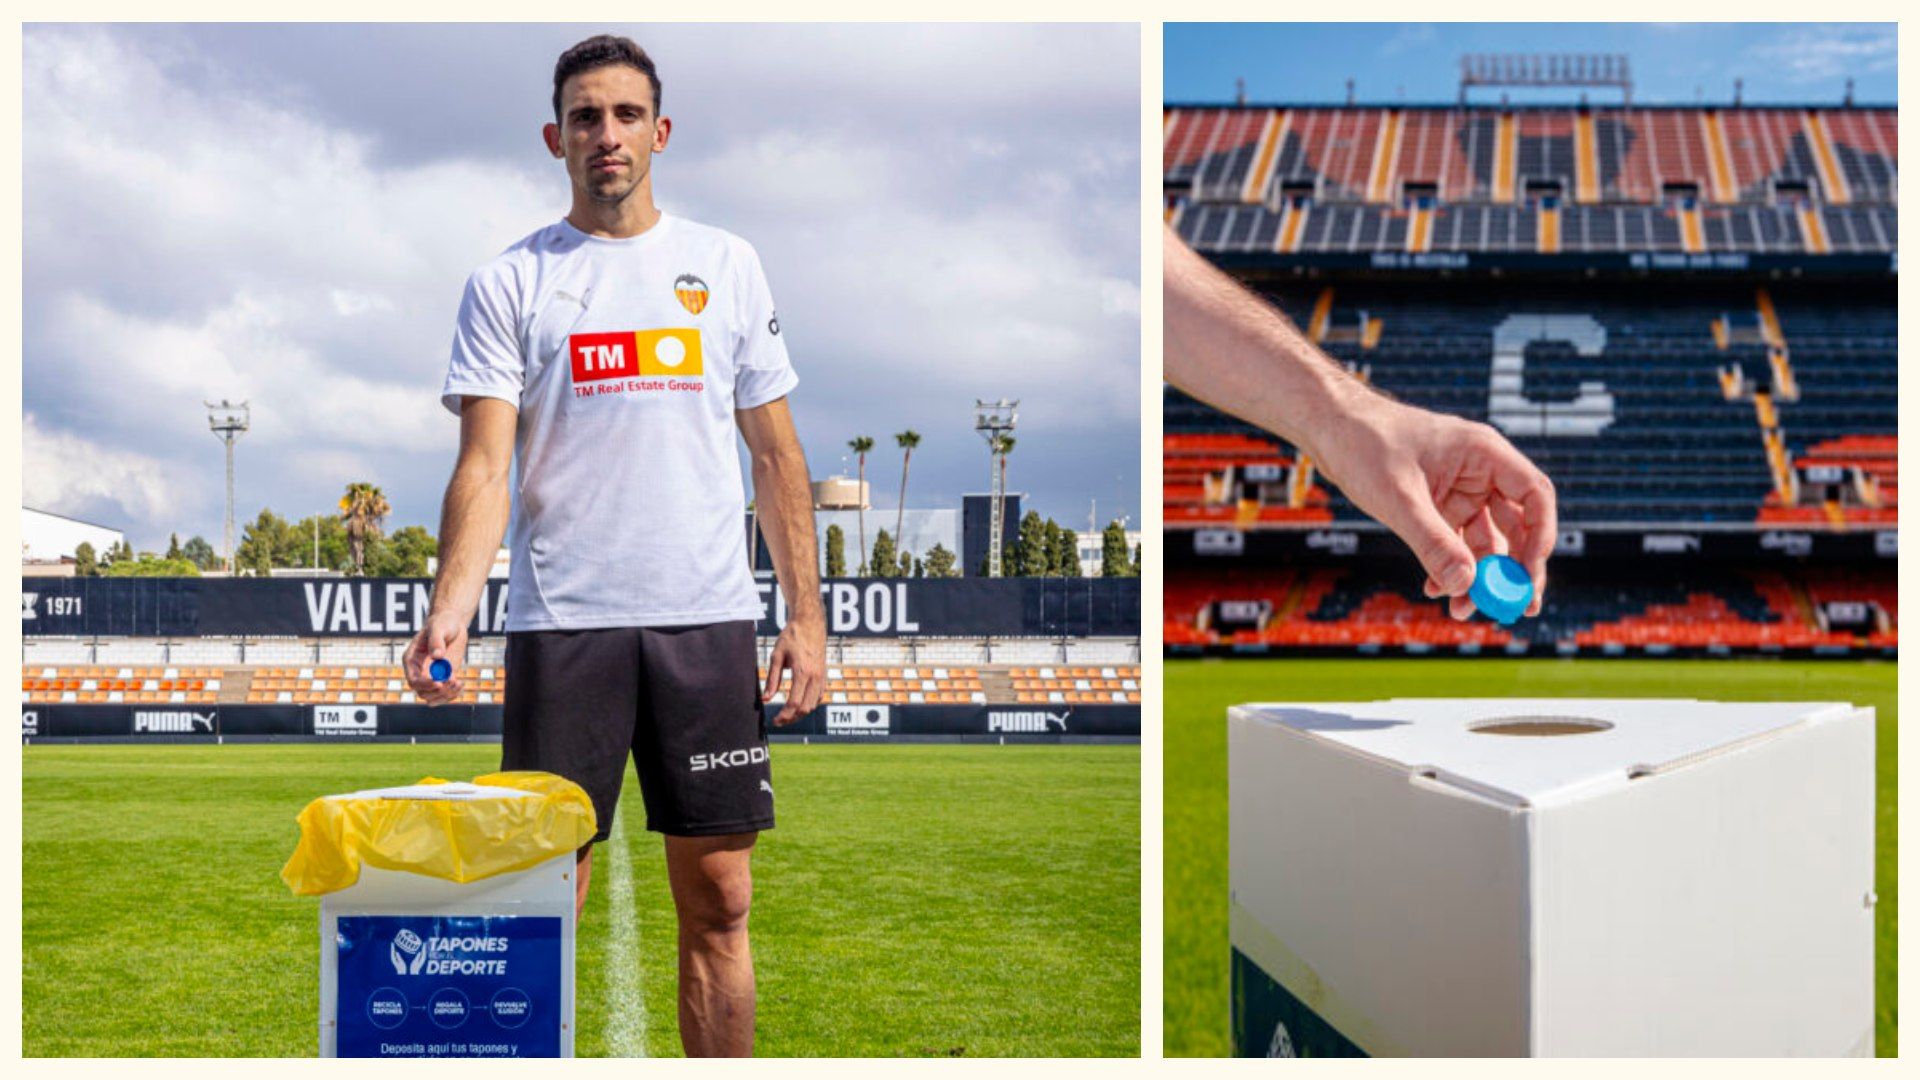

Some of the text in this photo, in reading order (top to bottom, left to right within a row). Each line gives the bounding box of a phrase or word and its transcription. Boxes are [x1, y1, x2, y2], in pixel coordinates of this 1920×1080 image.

[578, 344, 625, 371] TM
[1488, 313, 1615, 437] C
[574, 379, 704, 397] TM Real Estate Group
[45, 596, 82, 616] 1971
[303, 582, 509, 632] VALENIA
[134, 711, 194, 732] PUMA
[319, 712, 340, 723] TM
[831, 712, 852, 723] TM
[988, 711, 1049, 732] PUMA
[429, 937, 509, 952] TAPONES
[426, 959, 507, 975] DEPORTE
[380, 1043, 425, 1055] Deposita
[451, 1043, 467, 1054] tus
[469, 1043, 509, 1055] tapones
[511, 1045, 518, 1055] y
